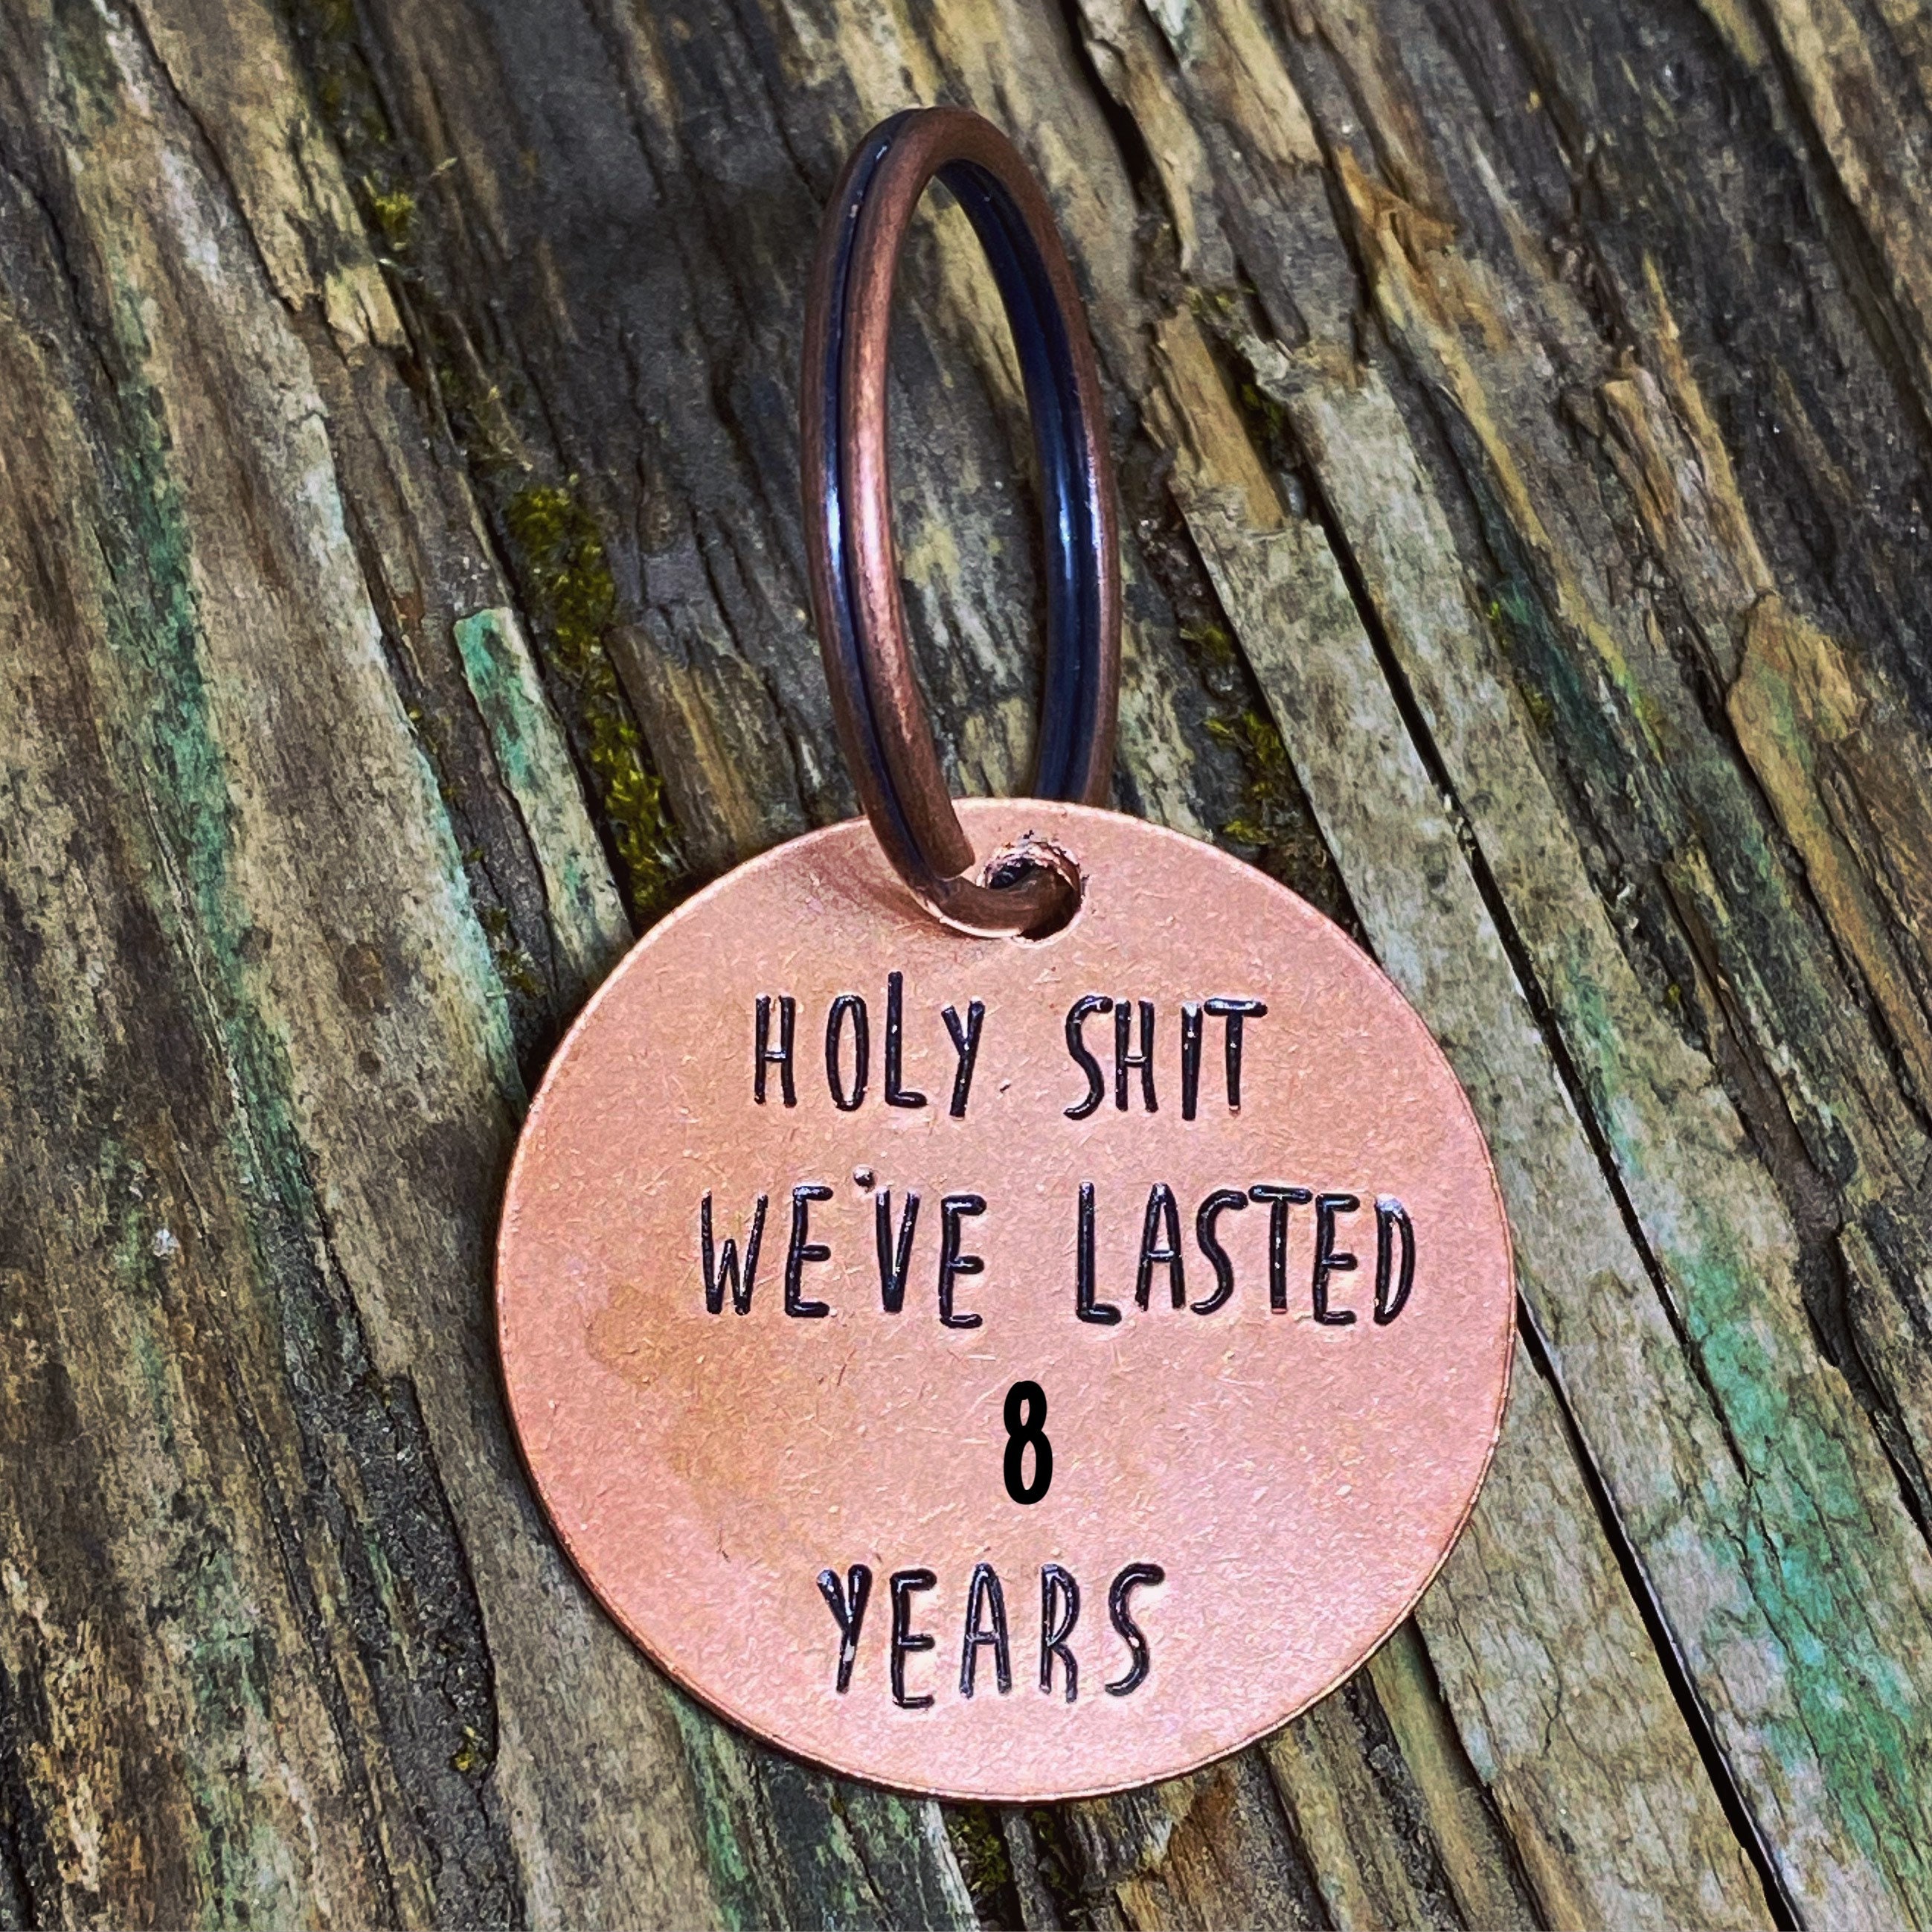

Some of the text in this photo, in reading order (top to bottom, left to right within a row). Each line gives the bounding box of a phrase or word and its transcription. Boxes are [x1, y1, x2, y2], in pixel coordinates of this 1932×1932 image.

[753, 970, 1268, 1121] HOLY SHIT
[701, 1165, 1416, 1329] WE'VE LASTED
[816, 1562, 1166, 1710] YEARS
